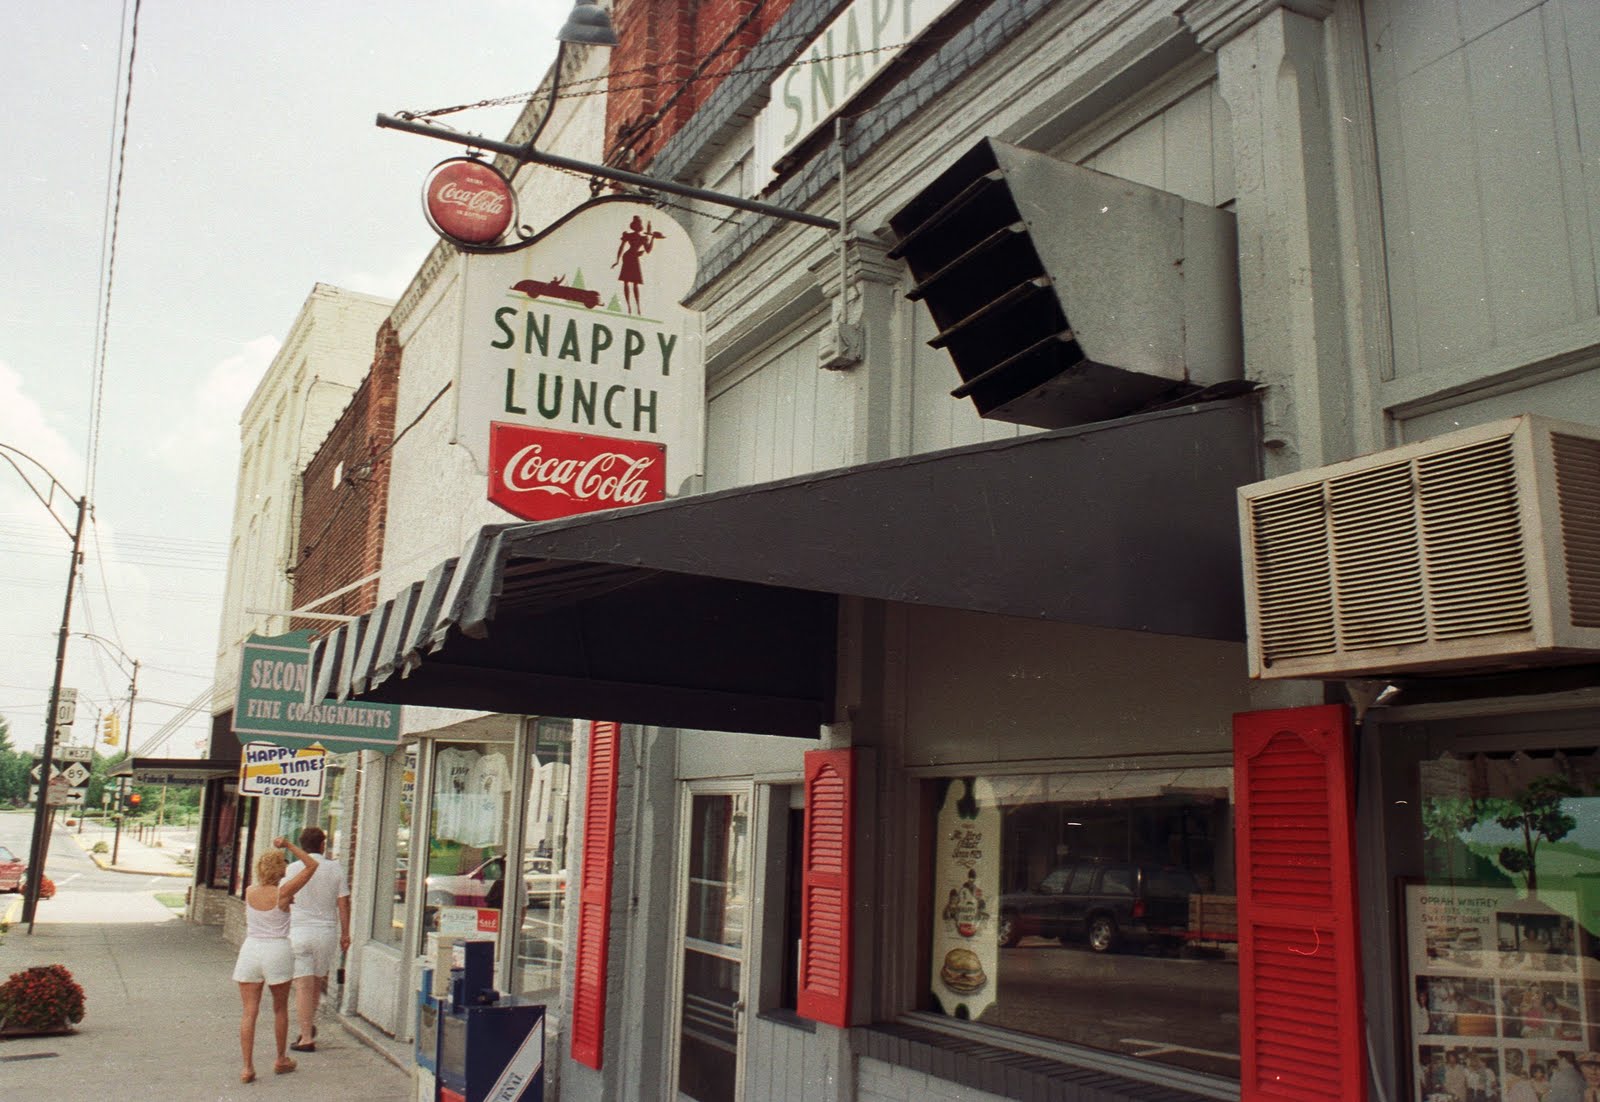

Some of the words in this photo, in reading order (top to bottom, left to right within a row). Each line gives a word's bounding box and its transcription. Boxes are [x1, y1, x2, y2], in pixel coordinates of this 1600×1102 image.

[437, 182, 507, 215] Coca-Cola
[490, 306, 678, 377] SNAPPY
[505, 368, 657, 433] LUNCH
[503, 444, 656, 504] Coca-Cola
[247, 699, 282, 719] FINE
[69, 750, 89, 758] WEST
[247, 748, 298, 763] HAPPY
[67, 768, 83, 779] 89
[280, 758, 325, 774] TIMES
[256, 775, 310, 788] BALLOONS
[273, 787, 301, 797] GIFTS
[1420, 896, 1453, 905] OPRAH
